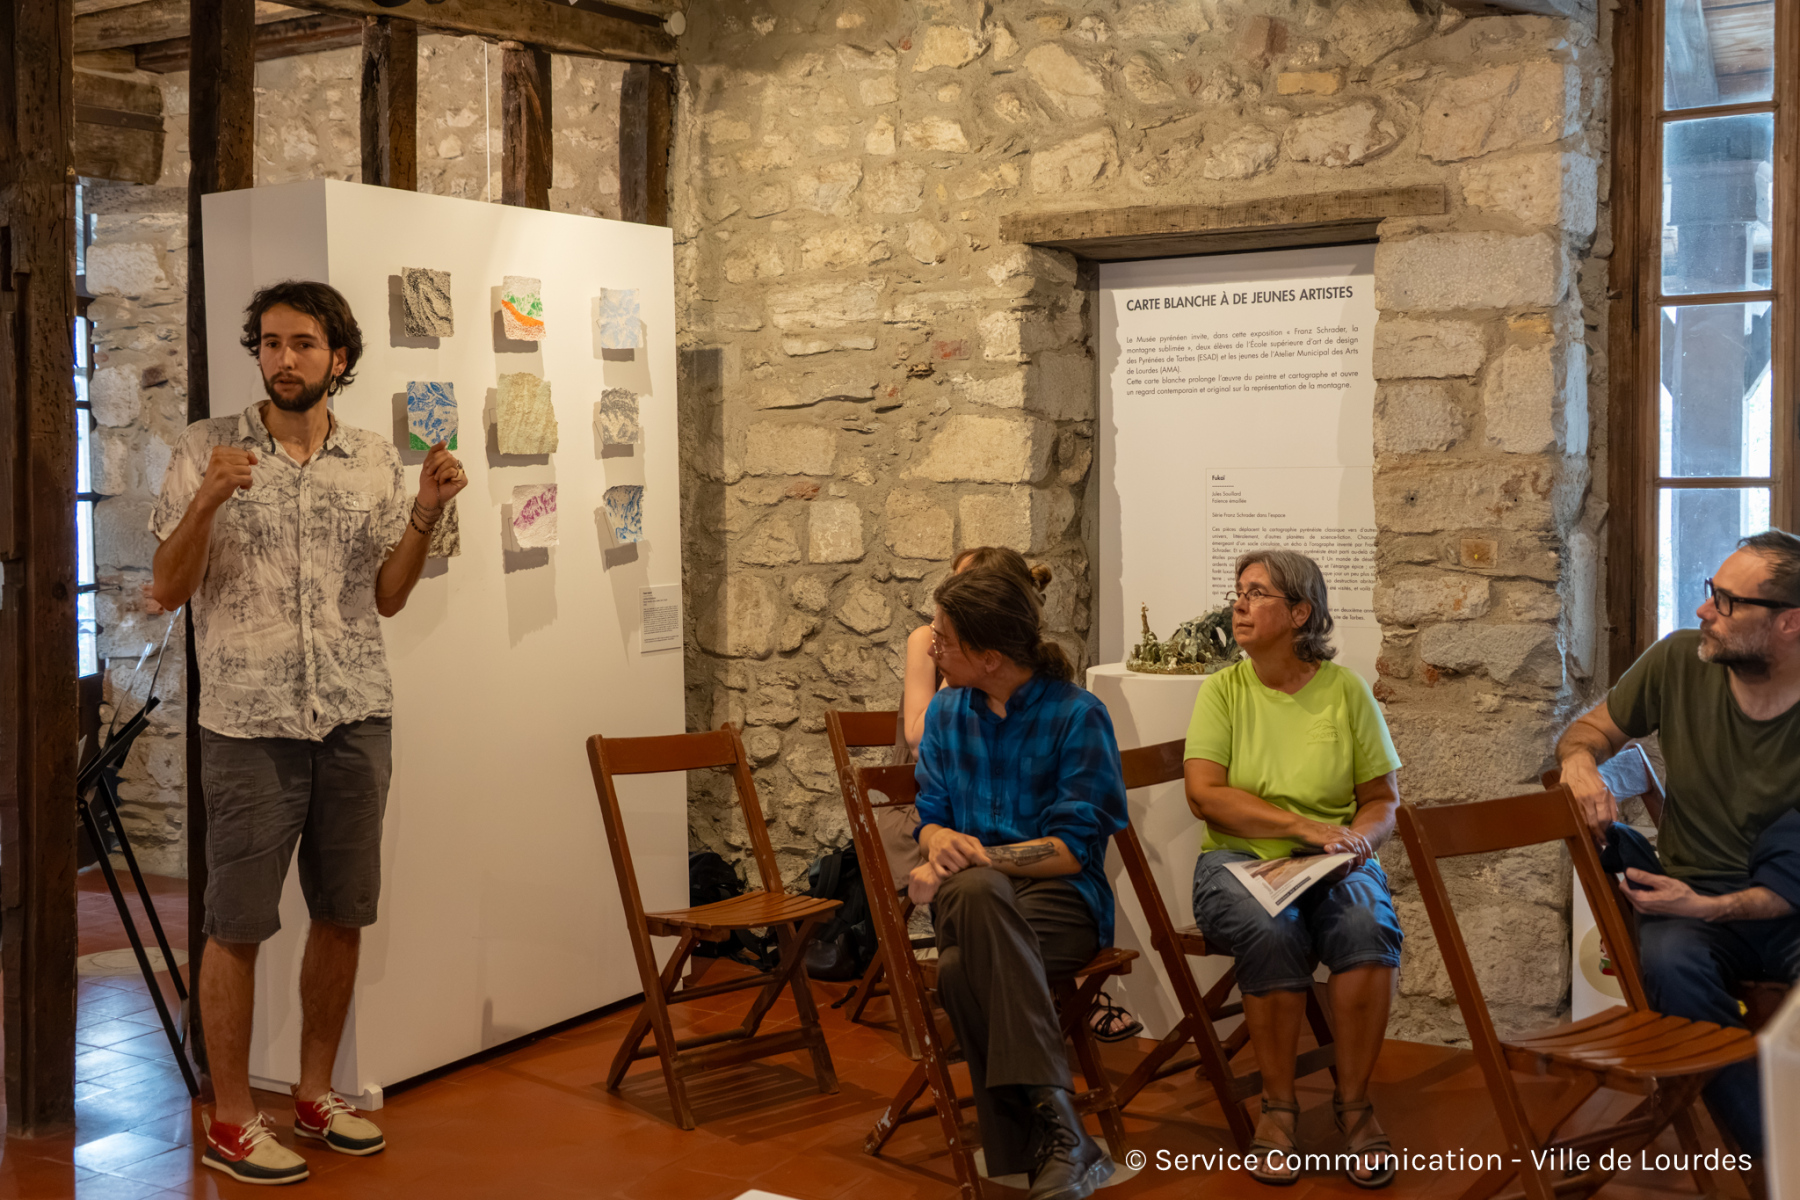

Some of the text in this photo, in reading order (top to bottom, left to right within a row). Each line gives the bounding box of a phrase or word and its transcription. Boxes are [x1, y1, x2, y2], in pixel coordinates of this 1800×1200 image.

[1126, 286, 1353, 311] CARTE BLANCHE À DE JEUNES ARTISTES
[1250, 330, 1282, 338] exposition
[1247, 340, 1267, 348] l'École
[1270, 339, 1303, 348] supérieure
[1336, 336, 1358, 345] design
[1139, 356, 1164, 364] Pyrénées
[1198, 354, 1218, 362] (ESAD)
[1239, 352, 1258, 361] jeunes
[1297, 348, 1330, 357] Municipal
[1160, 366, 1181, 374] (AMA).
[1188, 375, 1216, 384] prolonge
[1255, 373, 1276, 381] peintre
[1288, 371, 1328, 380] cartographe
[1136, 388, 1155, 396] regard
[1207, 385, 1231, 394] original
[1252, 383, 1296, 392] représentation
